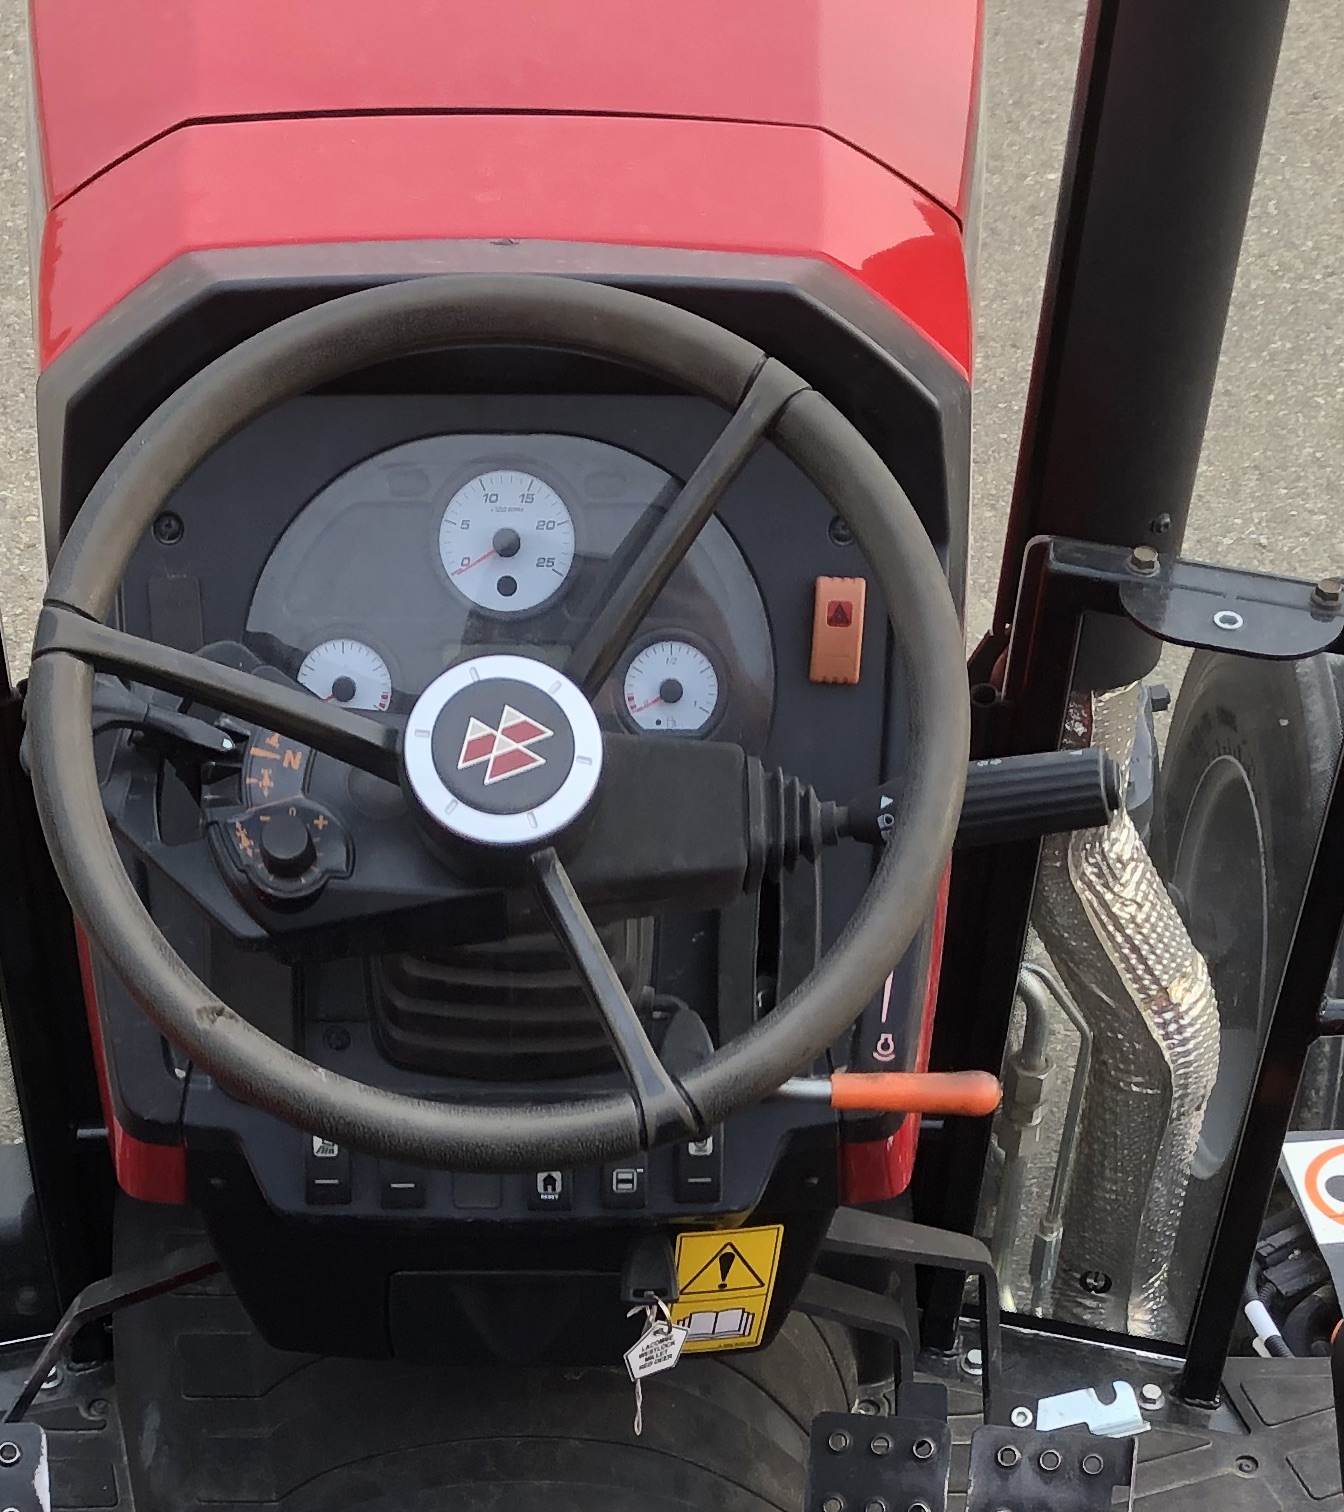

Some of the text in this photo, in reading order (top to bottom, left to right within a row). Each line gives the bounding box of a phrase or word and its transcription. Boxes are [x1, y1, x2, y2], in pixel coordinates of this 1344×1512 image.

[482, 493, 535, 504] 10 15
[460, 520, 471, 530] 5
[536, 520, 556, 531] 20
[460, 556, 471, 567] 0
[536, 557, 556, 568] 25
[282, 749, 303, 770] N
